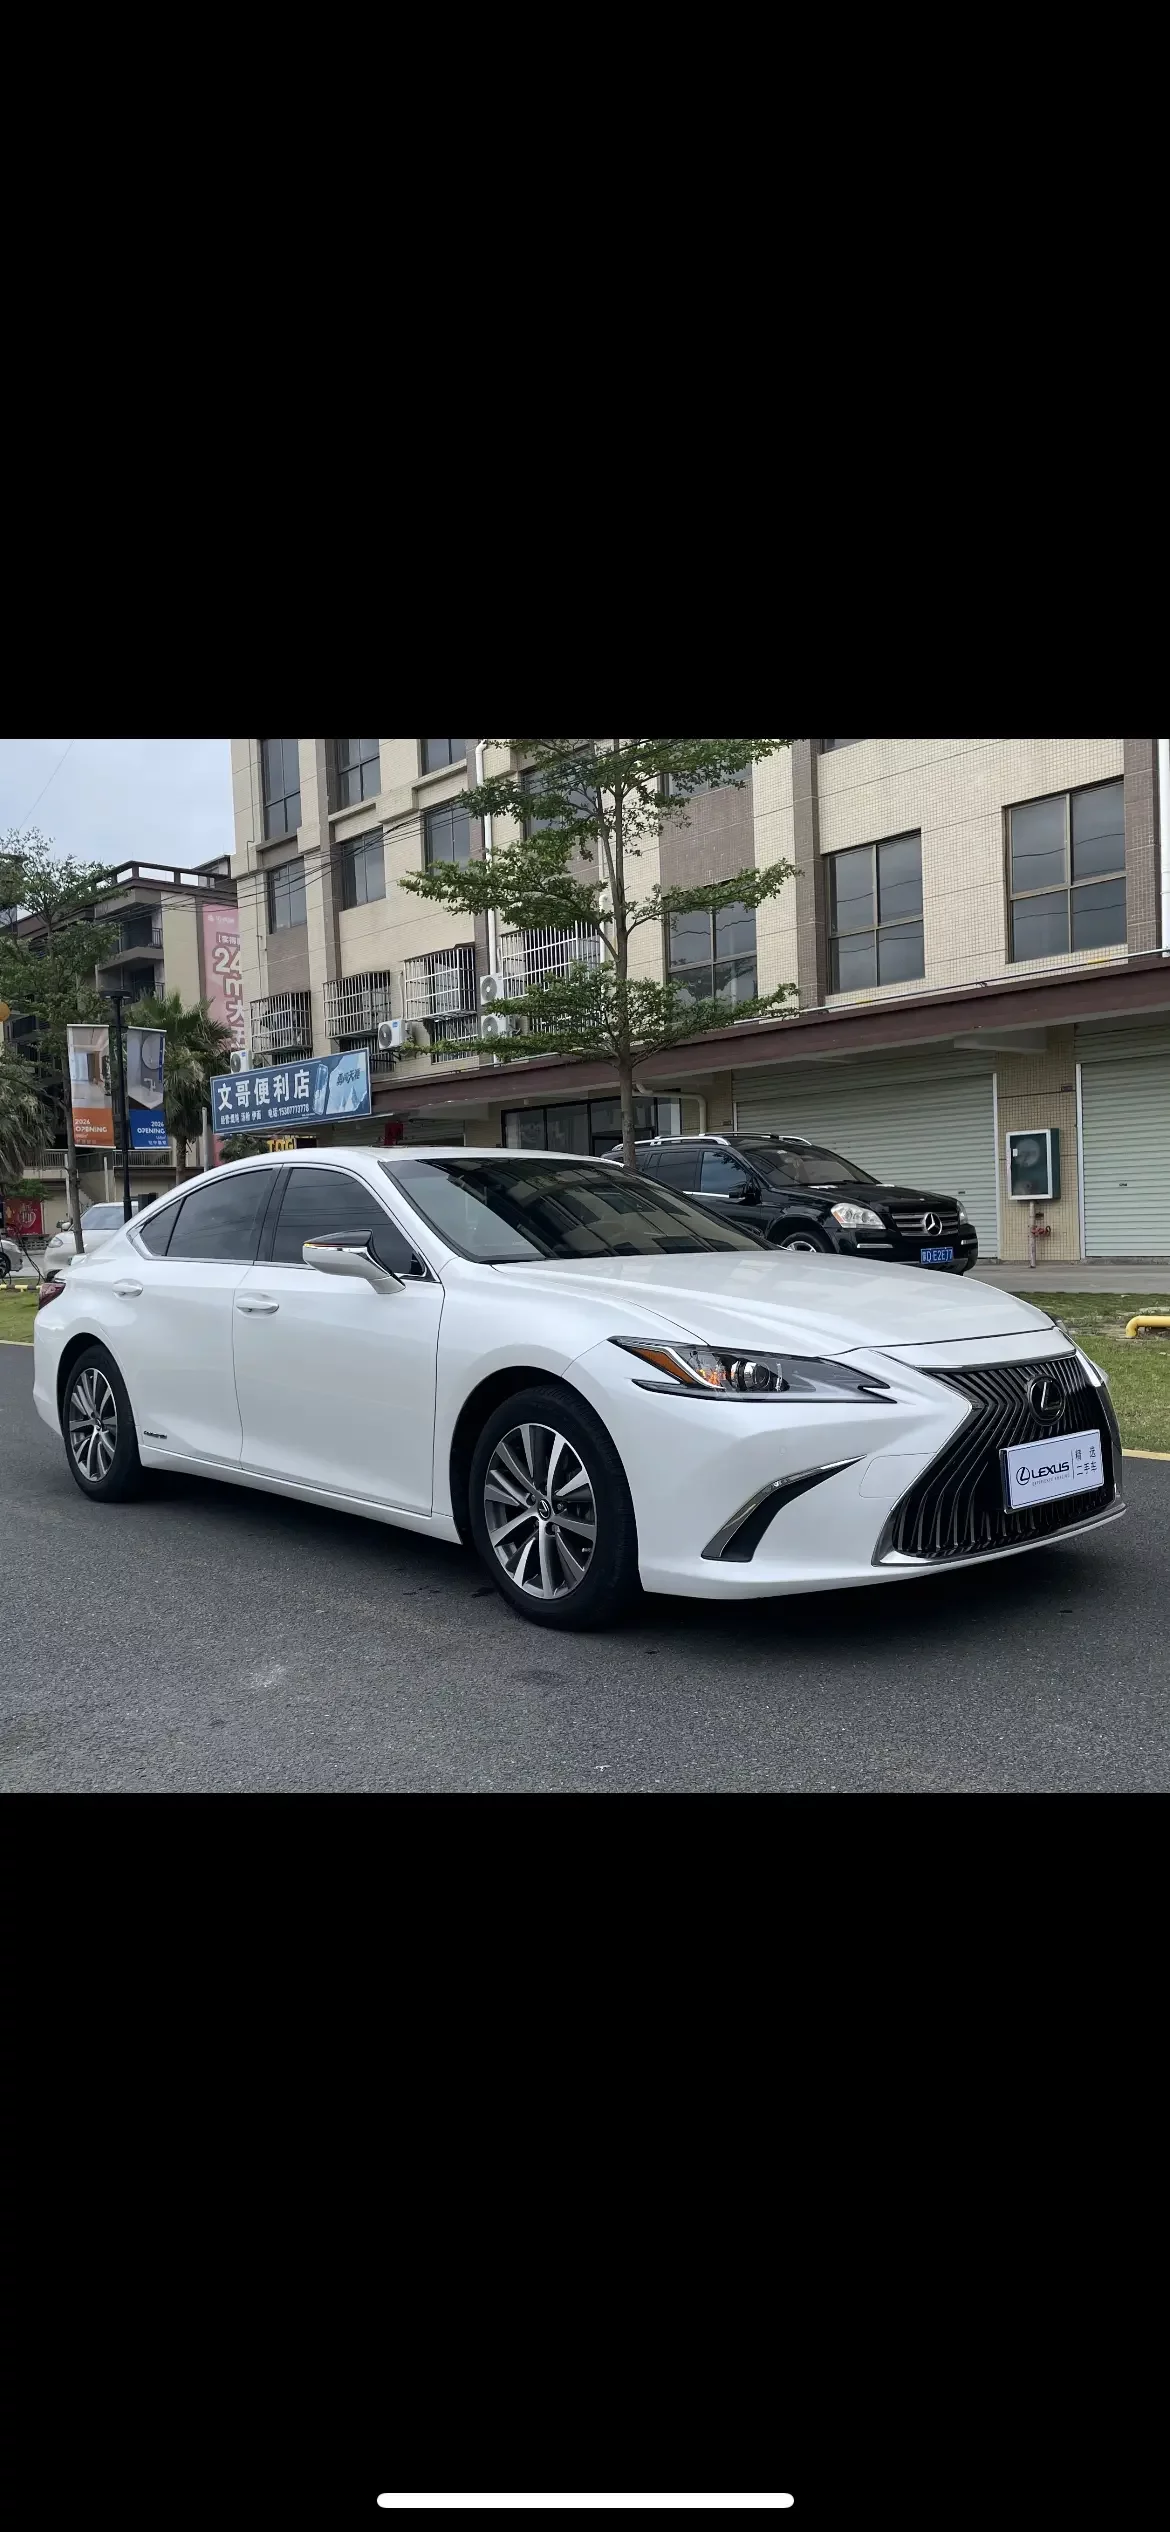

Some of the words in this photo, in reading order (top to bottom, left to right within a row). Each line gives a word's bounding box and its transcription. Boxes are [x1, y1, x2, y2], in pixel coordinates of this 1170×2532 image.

[218, 1069, 310, 1111] 文哥便利店
[1031, 1461, 1070, 1479] LEXUS
